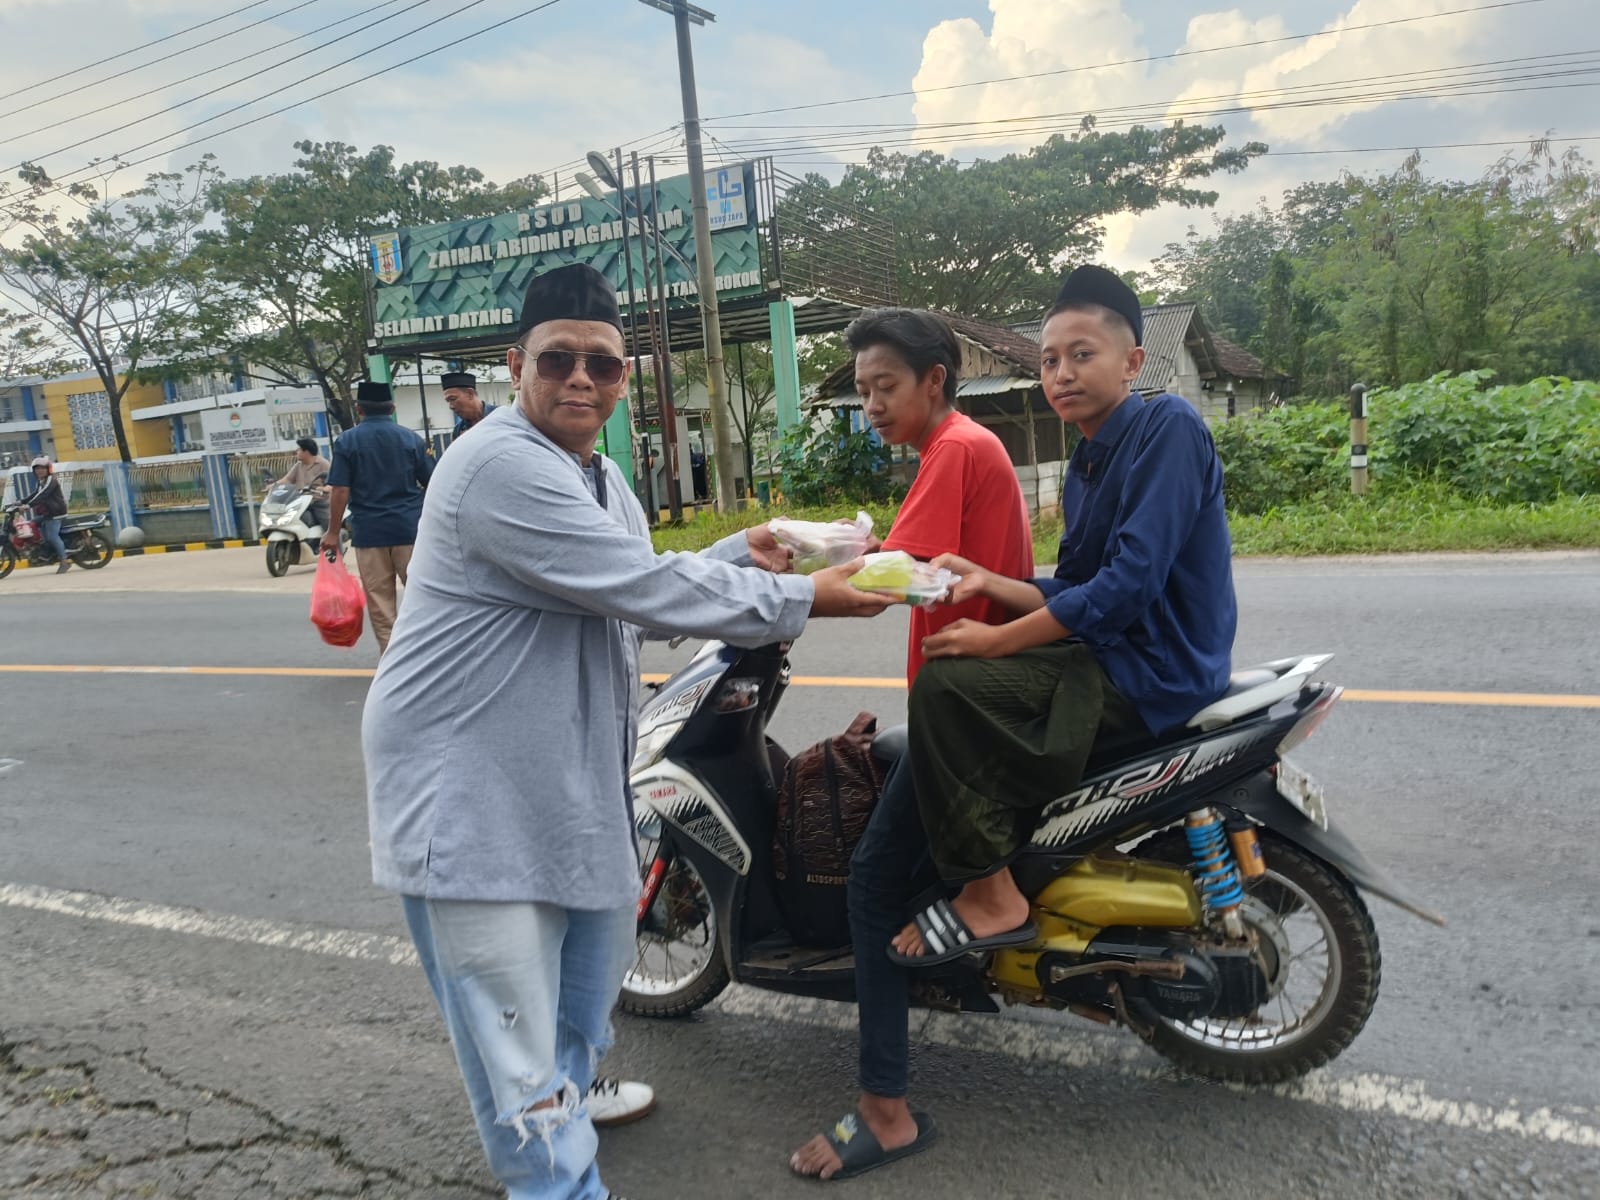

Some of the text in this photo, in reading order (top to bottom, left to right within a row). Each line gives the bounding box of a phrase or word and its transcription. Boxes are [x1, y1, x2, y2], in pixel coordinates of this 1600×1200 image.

[517, 203, 582, 232] RSUD
[428, 243, 493, 270] ZAINAL
[496, 230, 560, 259] ABIDIN
[714, 270, 761, 291] ROKOK
[374, 307, 514, 338] SELAMAT DATANG
[649, 784, 677, 800] YAMAHA
